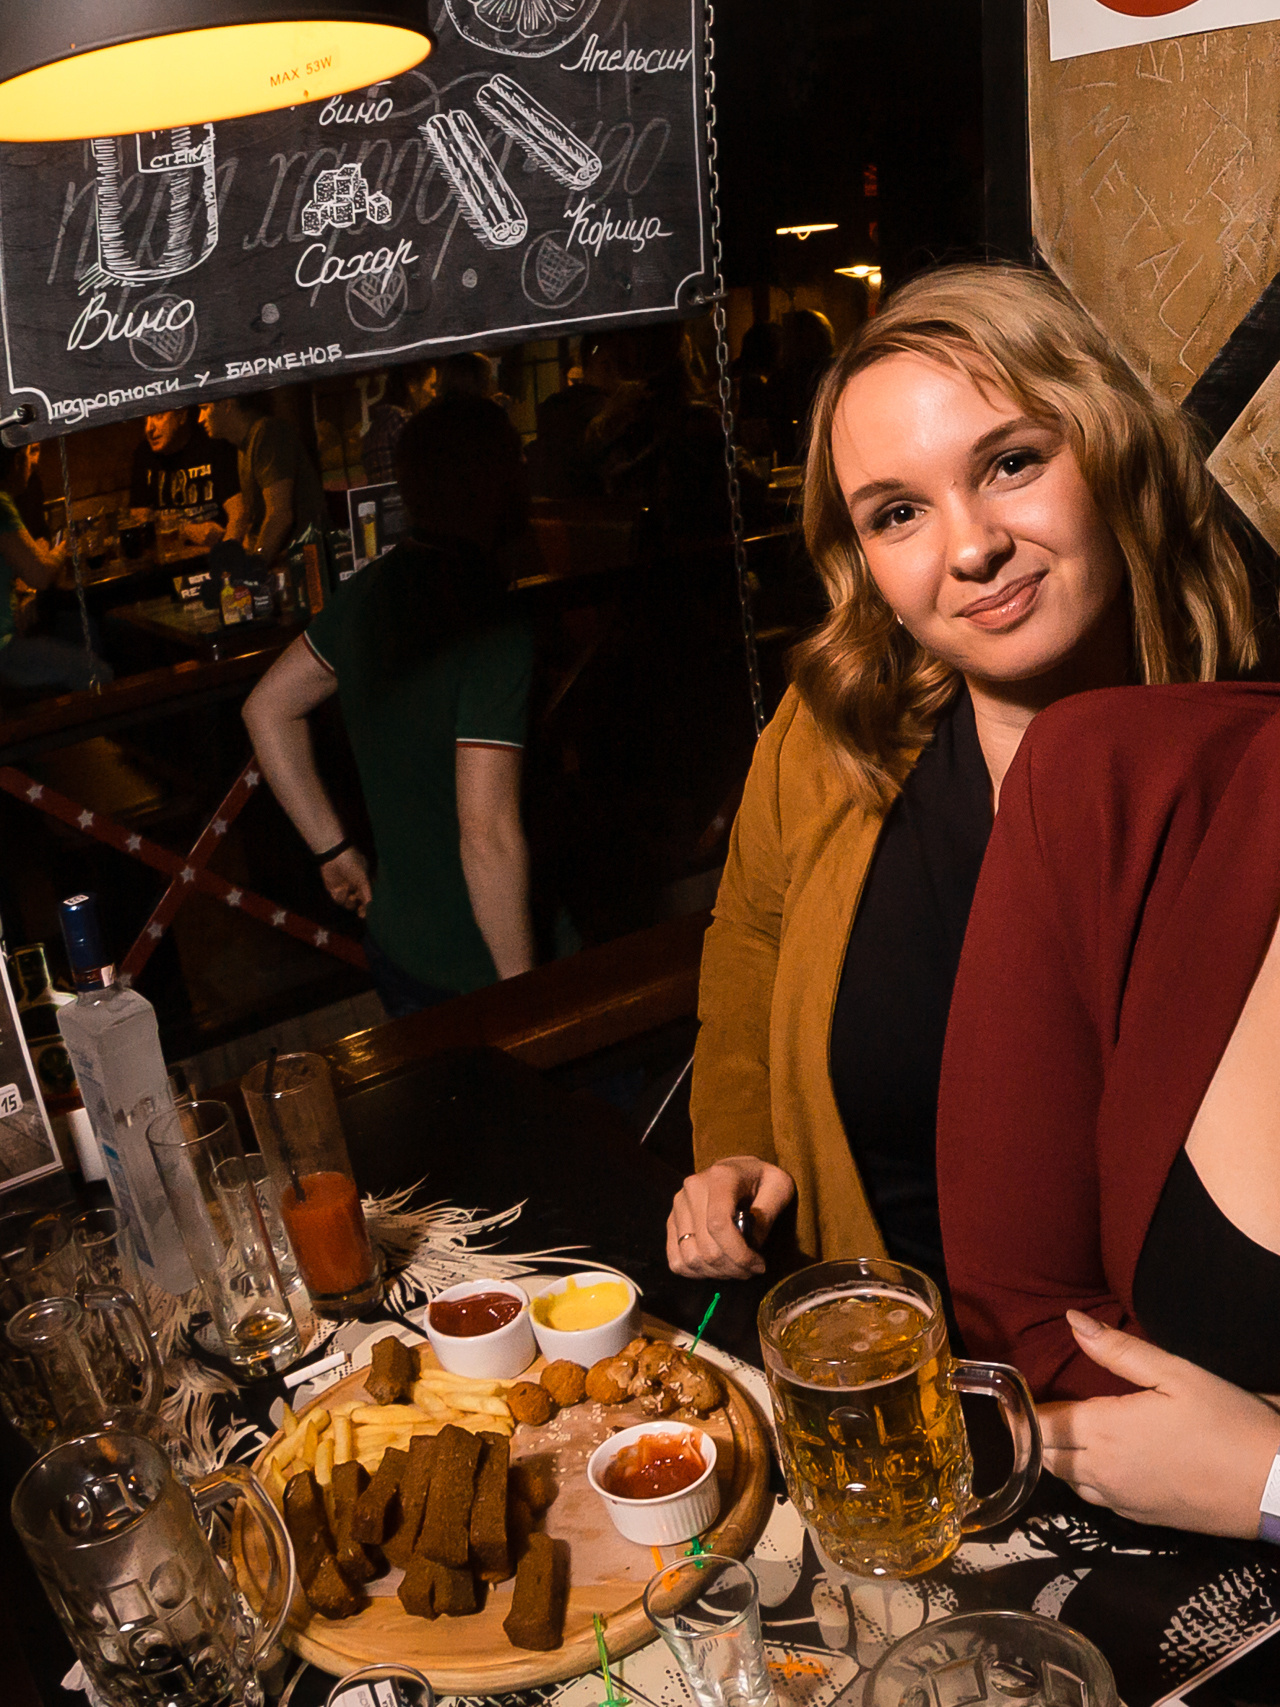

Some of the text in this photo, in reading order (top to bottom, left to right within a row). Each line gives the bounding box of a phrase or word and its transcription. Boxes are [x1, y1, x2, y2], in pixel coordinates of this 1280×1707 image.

[269, 54, 332, 88] MAX 53W
[560, 34, 693, 73] Апельсин
[318, 95, 393, 126] вино
[563, 197, 674, 257] Корица
[295, 238, 420, 294] Сахар
[66, 292, 195, 351] Вино
[225, 343, 343, 380] БАРМЕНОВ
